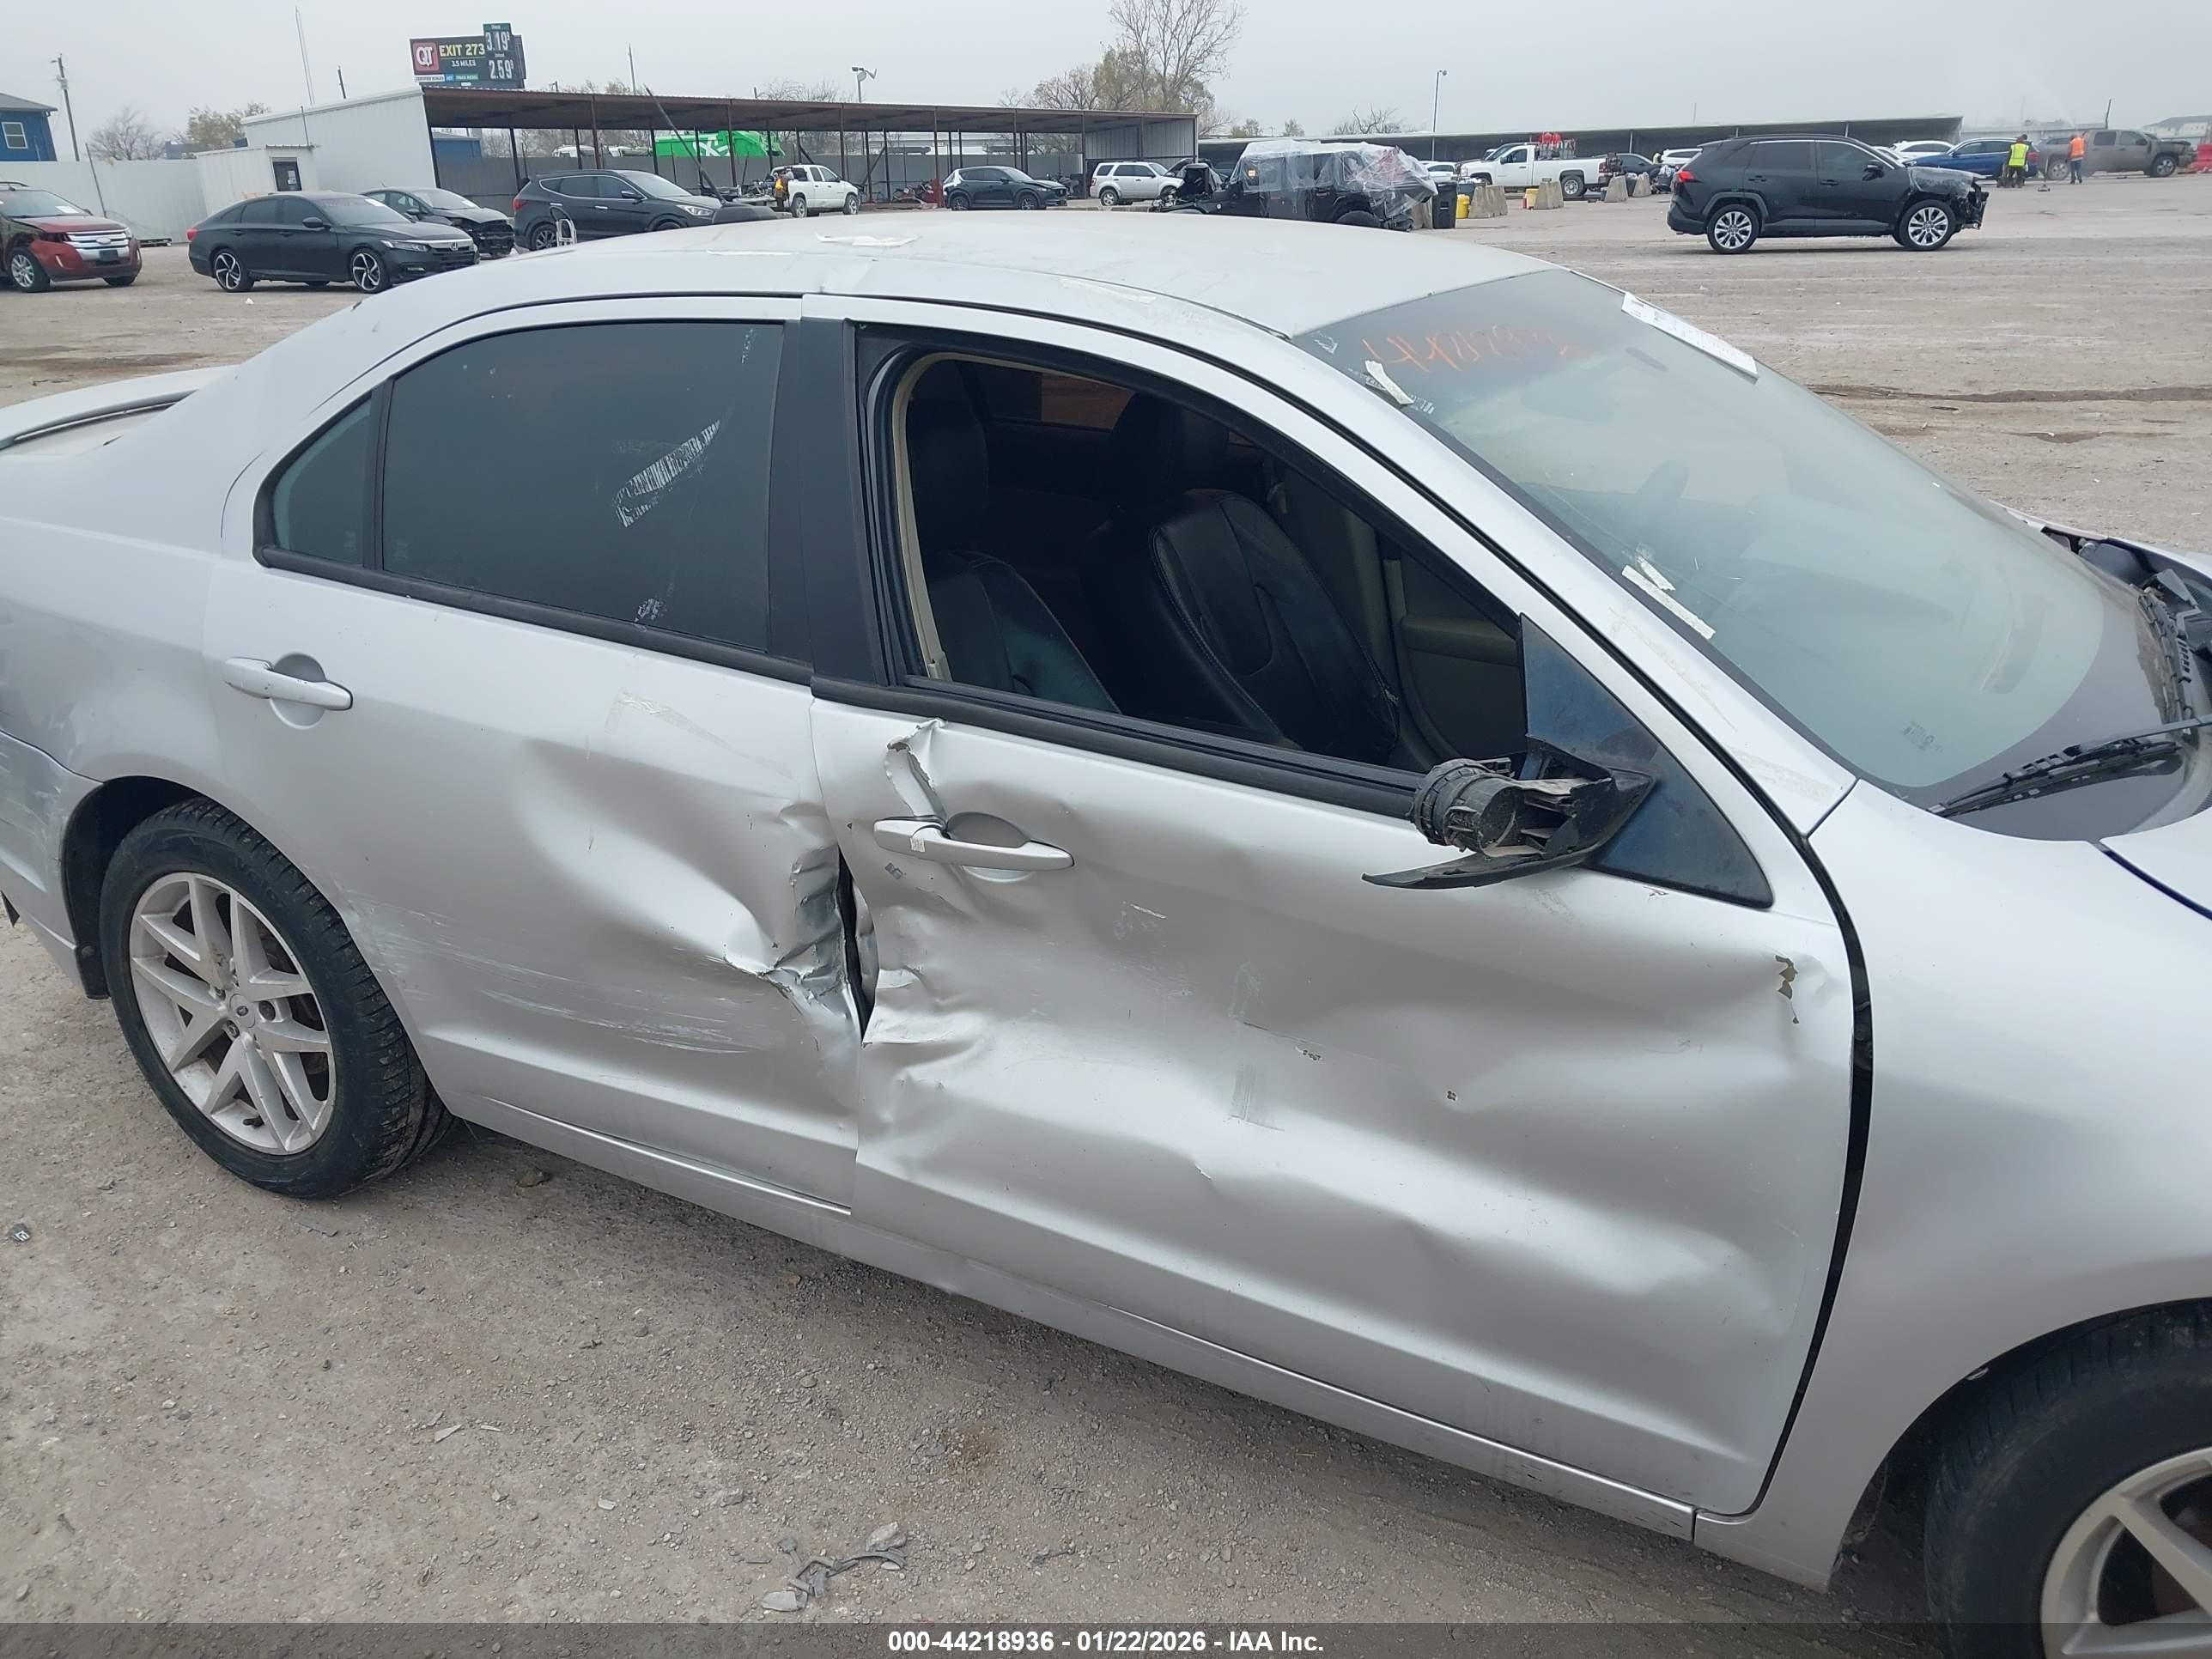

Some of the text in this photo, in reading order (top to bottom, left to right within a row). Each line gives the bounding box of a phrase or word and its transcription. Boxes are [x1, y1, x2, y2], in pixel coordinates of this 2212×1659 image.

[416, 46, 433, 66] QT
[439, 43, 485, 57] EXIT 273
